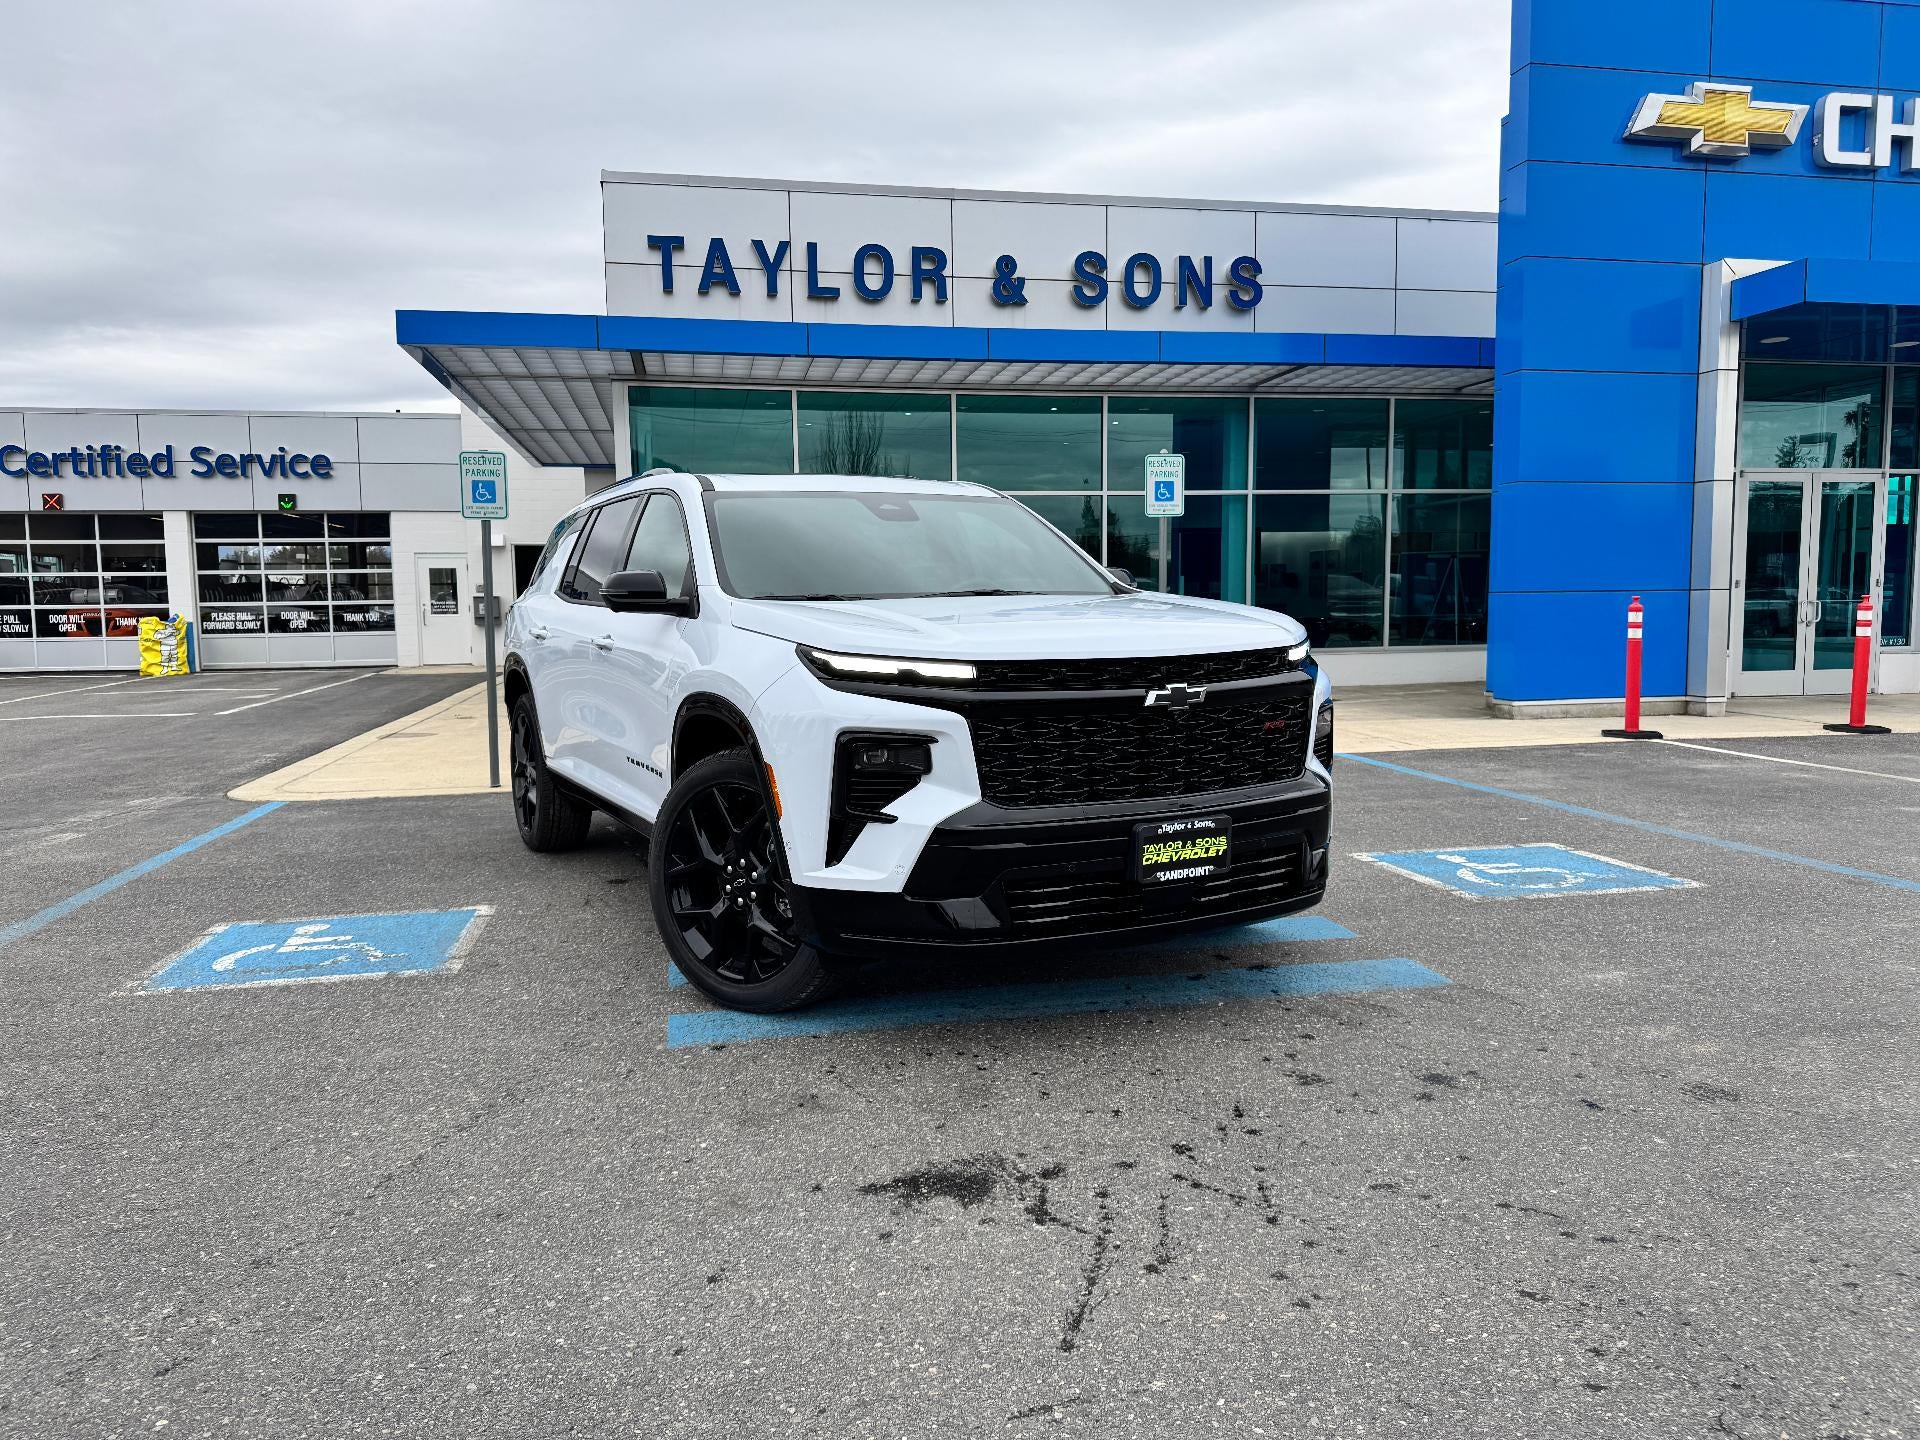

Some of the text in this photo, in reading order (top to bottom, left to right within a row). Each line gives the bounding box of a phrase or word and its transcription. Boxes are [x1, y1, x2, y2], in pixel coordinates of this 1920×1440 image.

[647, 234, 1263, 310] TAYLOR & SONS
[0, 444, 333, 479] Certified Service
[462, 456, 503, 466] RESERVED
[1148, 460, 1181, 468] RESERVED
[465, 468, 501, 478] PARKING
[1150, 470, 1179, 478] PARKING
[3, 614, 21, 624] PULL
[49, 614, 67, 624] DOOR
[68, 614, 86, 624] WILL
[211, 611, 252, 621] PLEASE PULL
[281, 611, 315, 620] DOOR WILL
[343, 612, 380, 621] THANK YOU!
[115, 617, 138, 626] THANK
[202, 620, 261, 630] FORWARD SLOWLY
[289, 620, 307, 628] OPEN
[2, 623, 30, 633] SLOWLY
[58, 623, 77, 632] OPEN
[626, 755, 664, 779] TRAVERSE
[1161, 822, 1186, 834] Taylor
[1193, 820, 1213, 829] Sons
[1142, 836, 1227, 854] TAYLOR & SONS
[1142, 846, 1227, 865] CHEVROLET
[1159, 865, 1210, 882] SANDPOINT
